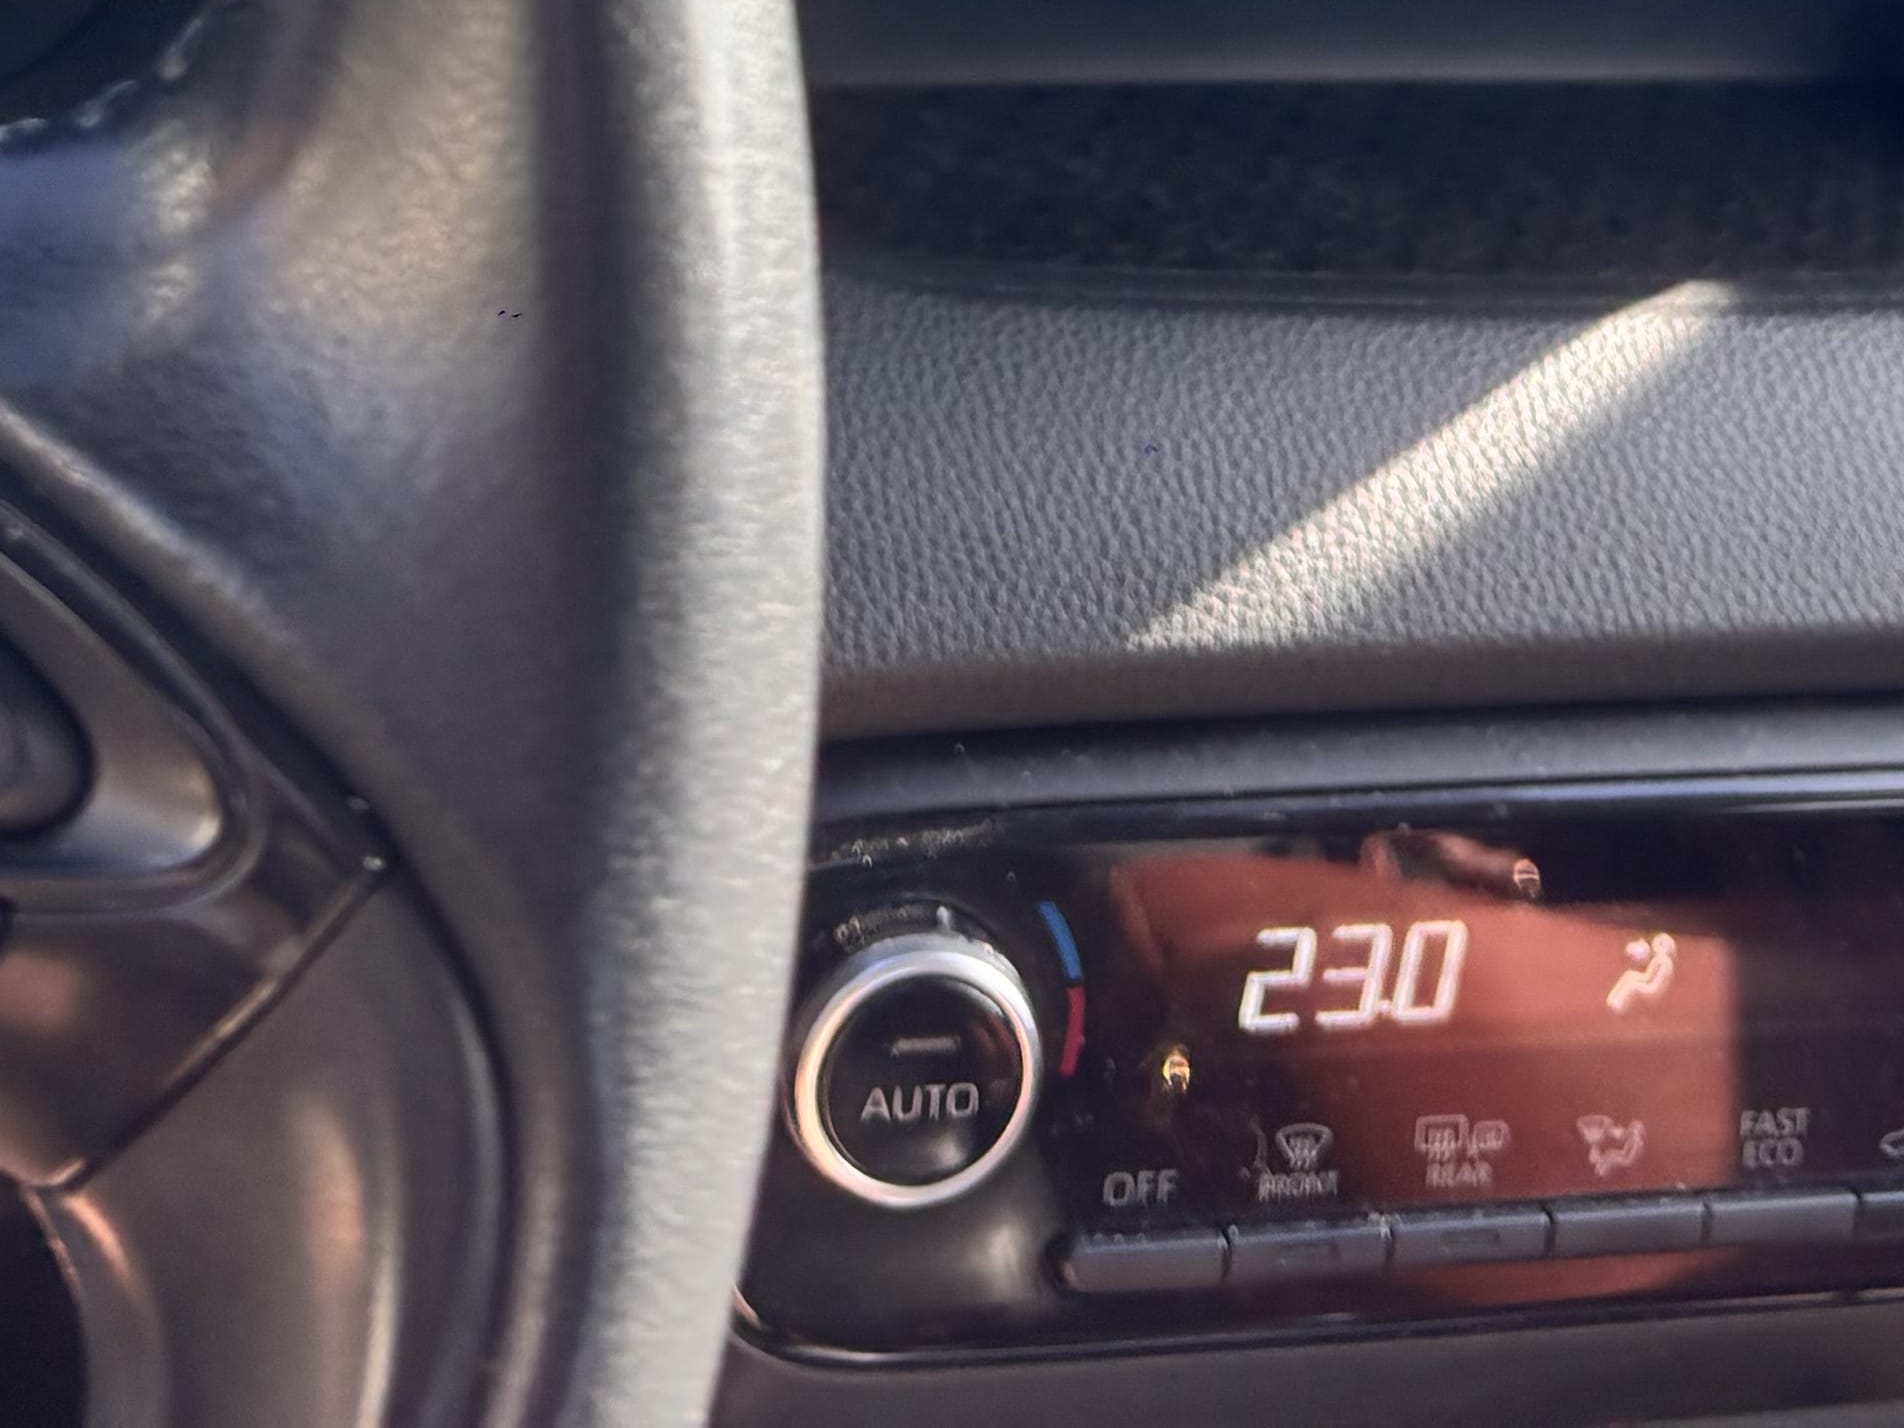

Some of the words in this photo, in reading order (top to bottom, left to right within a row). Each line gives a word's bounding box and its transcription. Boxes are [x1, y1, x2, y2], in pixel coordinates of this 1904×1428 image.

[861, 1080, 980, 1122] AUTO
[1739, 1106, 1811, 1141] FAST
[1741, 1139, 1804, 1169] ECO
[1102, 1167, 1180, 1209] OFF
